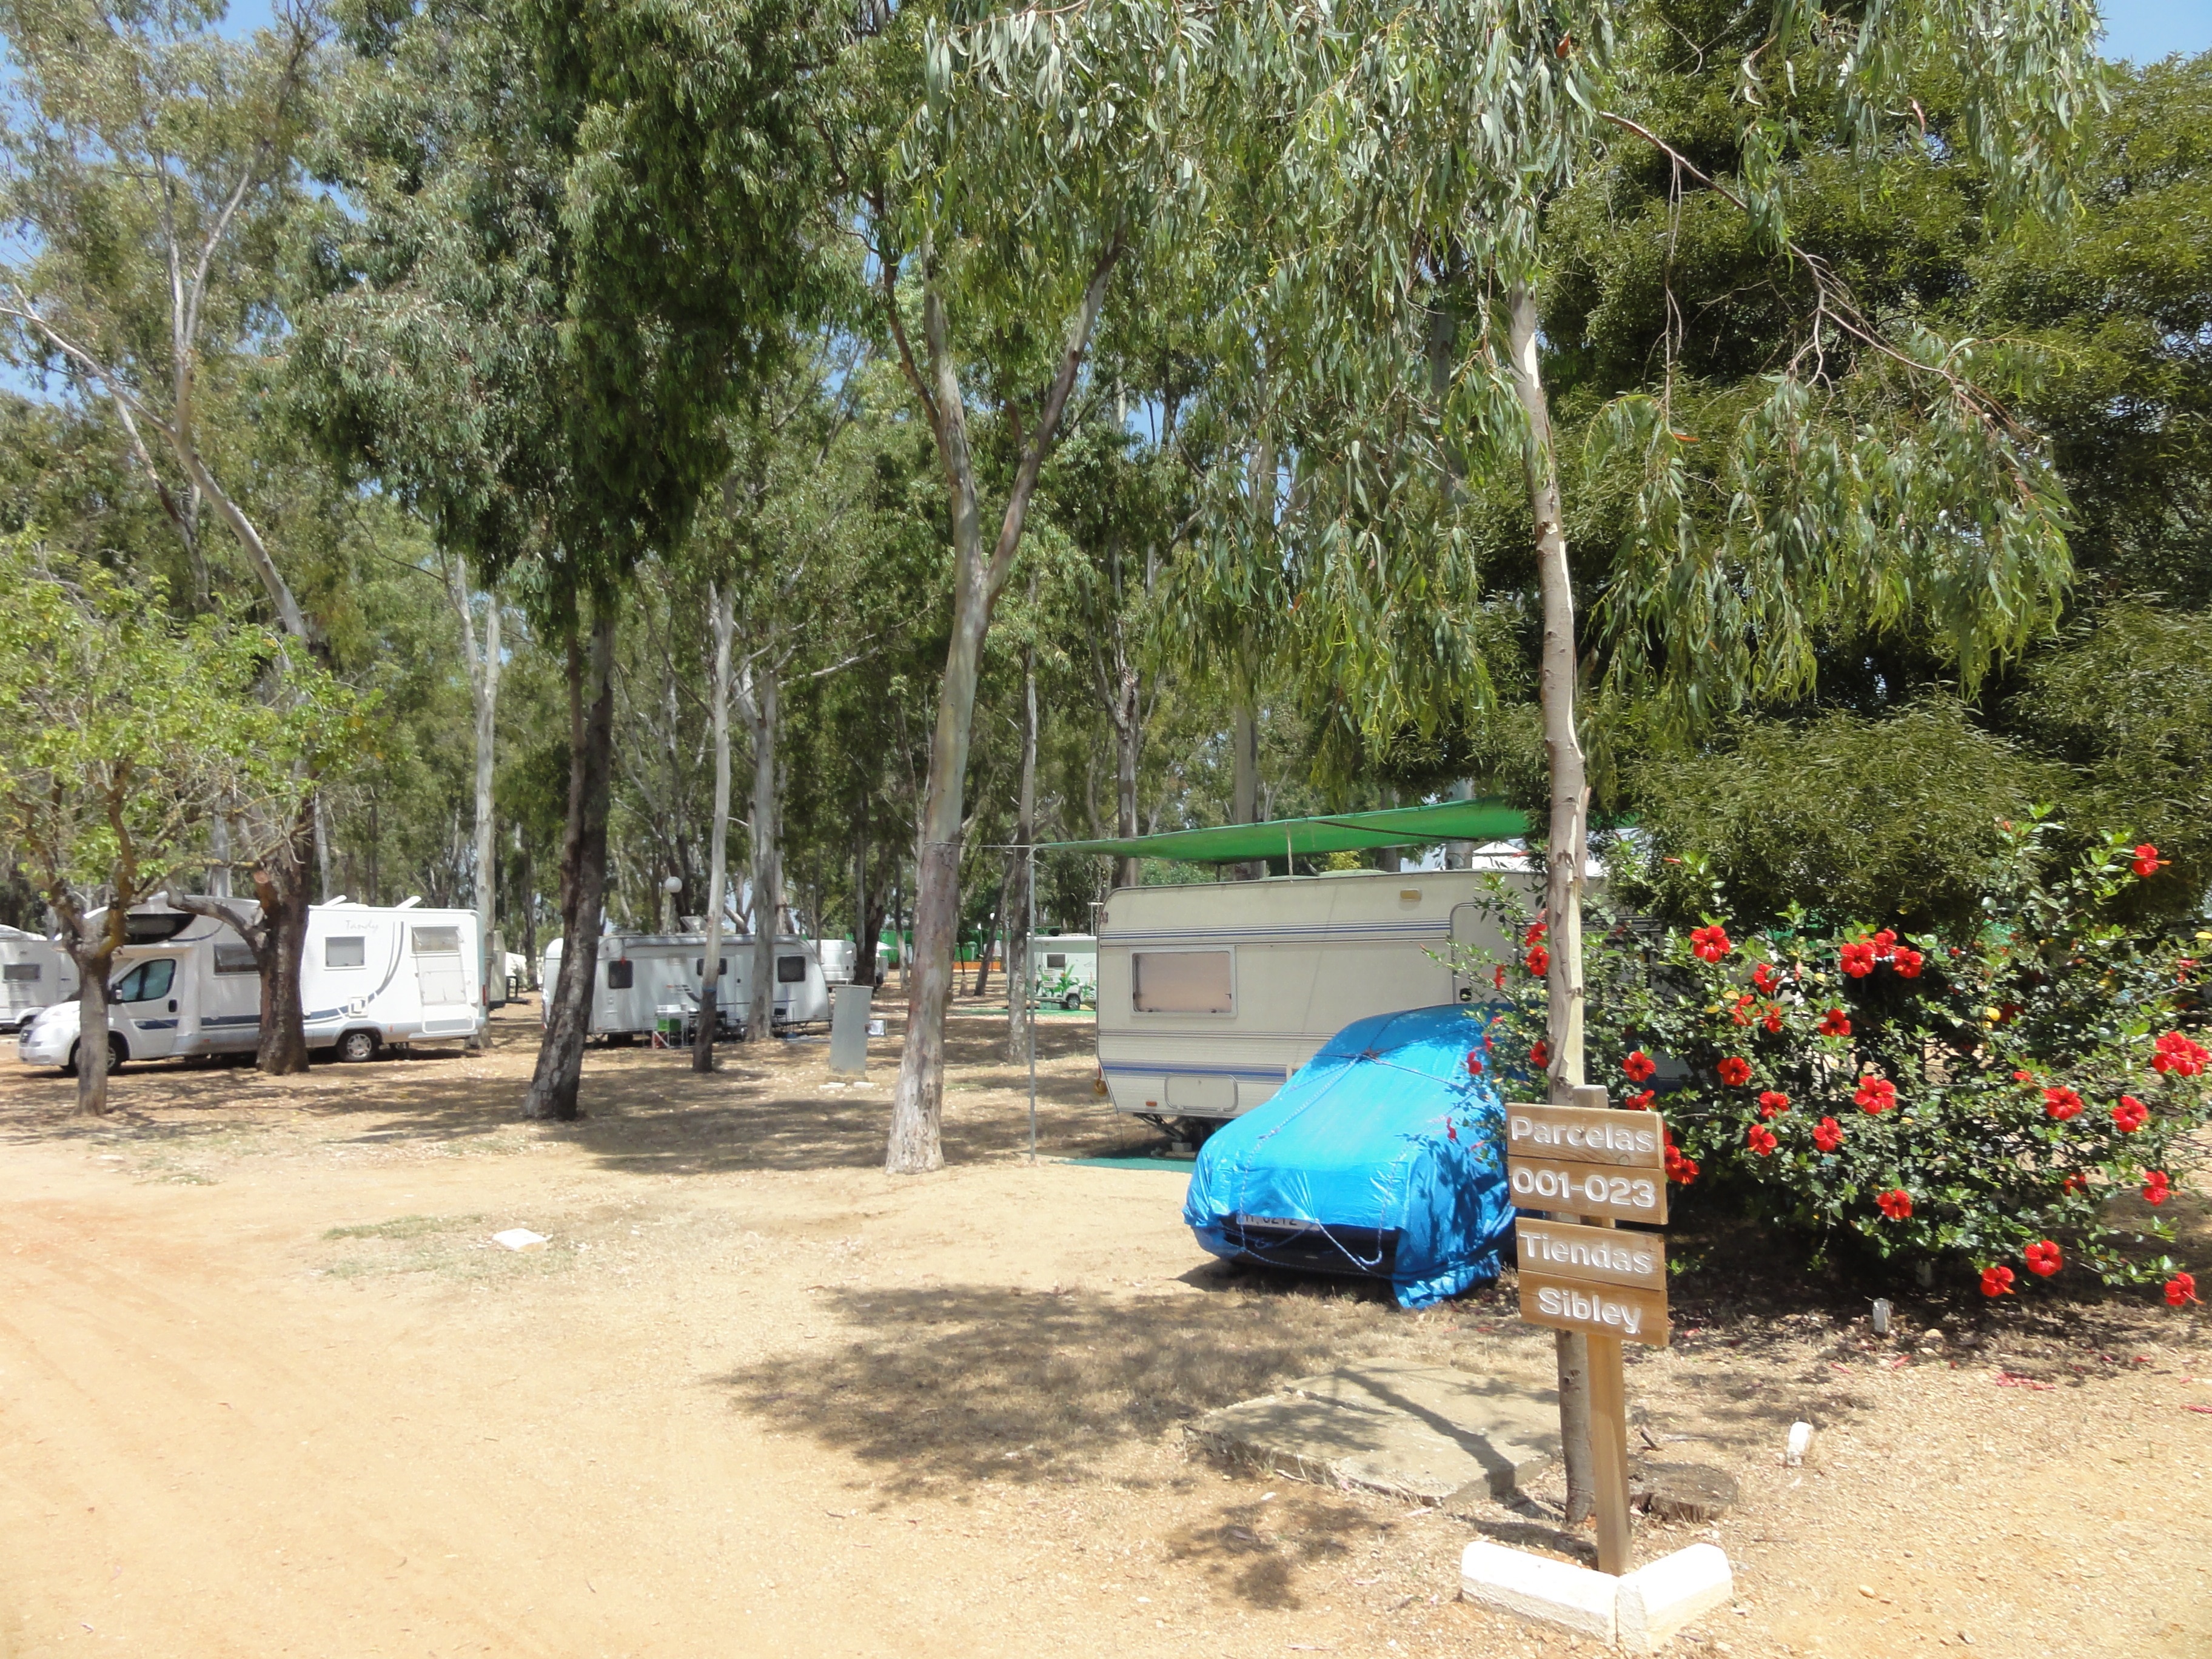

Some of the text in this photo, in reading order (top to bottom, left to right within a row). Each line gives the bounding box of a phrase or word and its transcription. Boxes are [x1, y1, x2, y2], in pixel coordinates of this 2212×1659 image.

[1510, 1116, 1655, 1153] Parcelas
[1512, 1167, 1655, 1208] 001-023
[1520, 1231, 1652, 1274] Tiendas
[1538, 1287, 1641, 1334] Sibley
